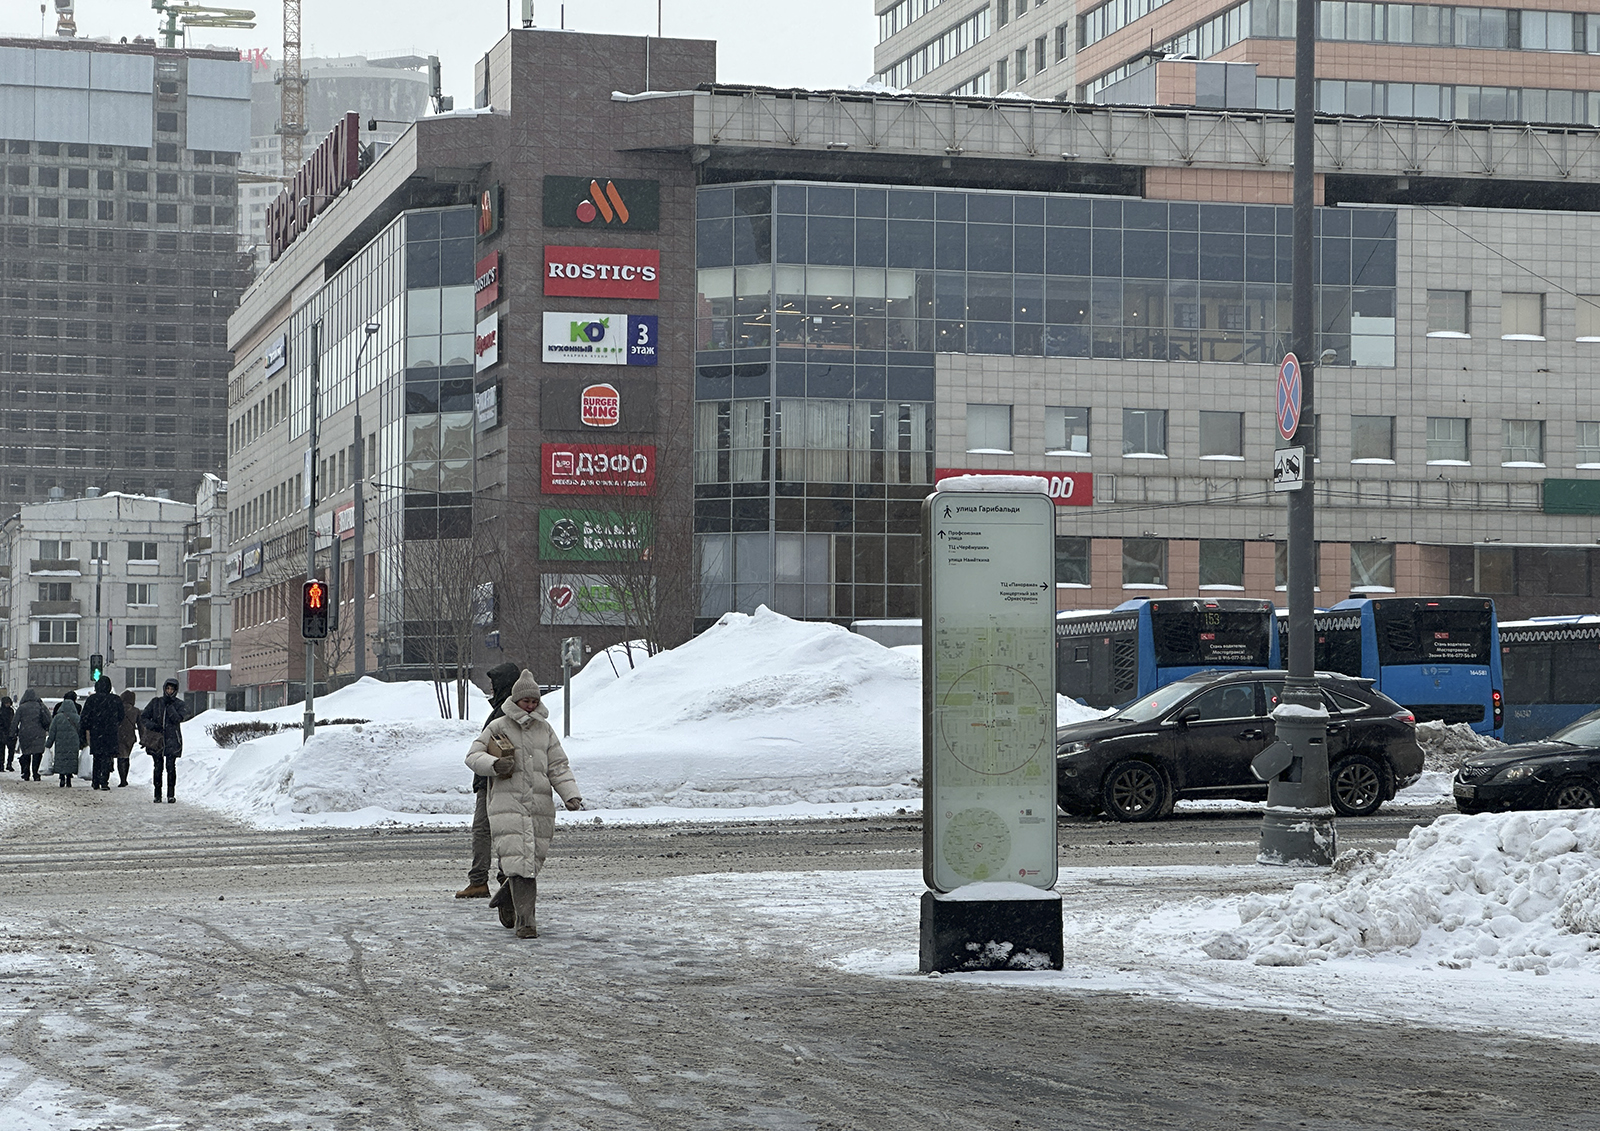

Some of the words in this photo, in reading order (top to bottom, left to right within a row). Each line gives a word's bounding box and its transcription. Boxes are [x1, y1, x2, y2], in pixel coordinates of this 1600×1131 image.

[548, 262, 656, 281] ROSTIC'S
[637, 323, 649, 345] 3
[547, 344, 593, 353] КУХОННЫЙ
[631, 345, 655, 355] этаж
[583, 398, 618, 406] BURGER
[583, 406, 618, 418] KING
[576, 453, 648, 476] ДЭФО
[979, 505, 1021, 513] Гарибальди
[1204, 612, 1220, 625] 153
